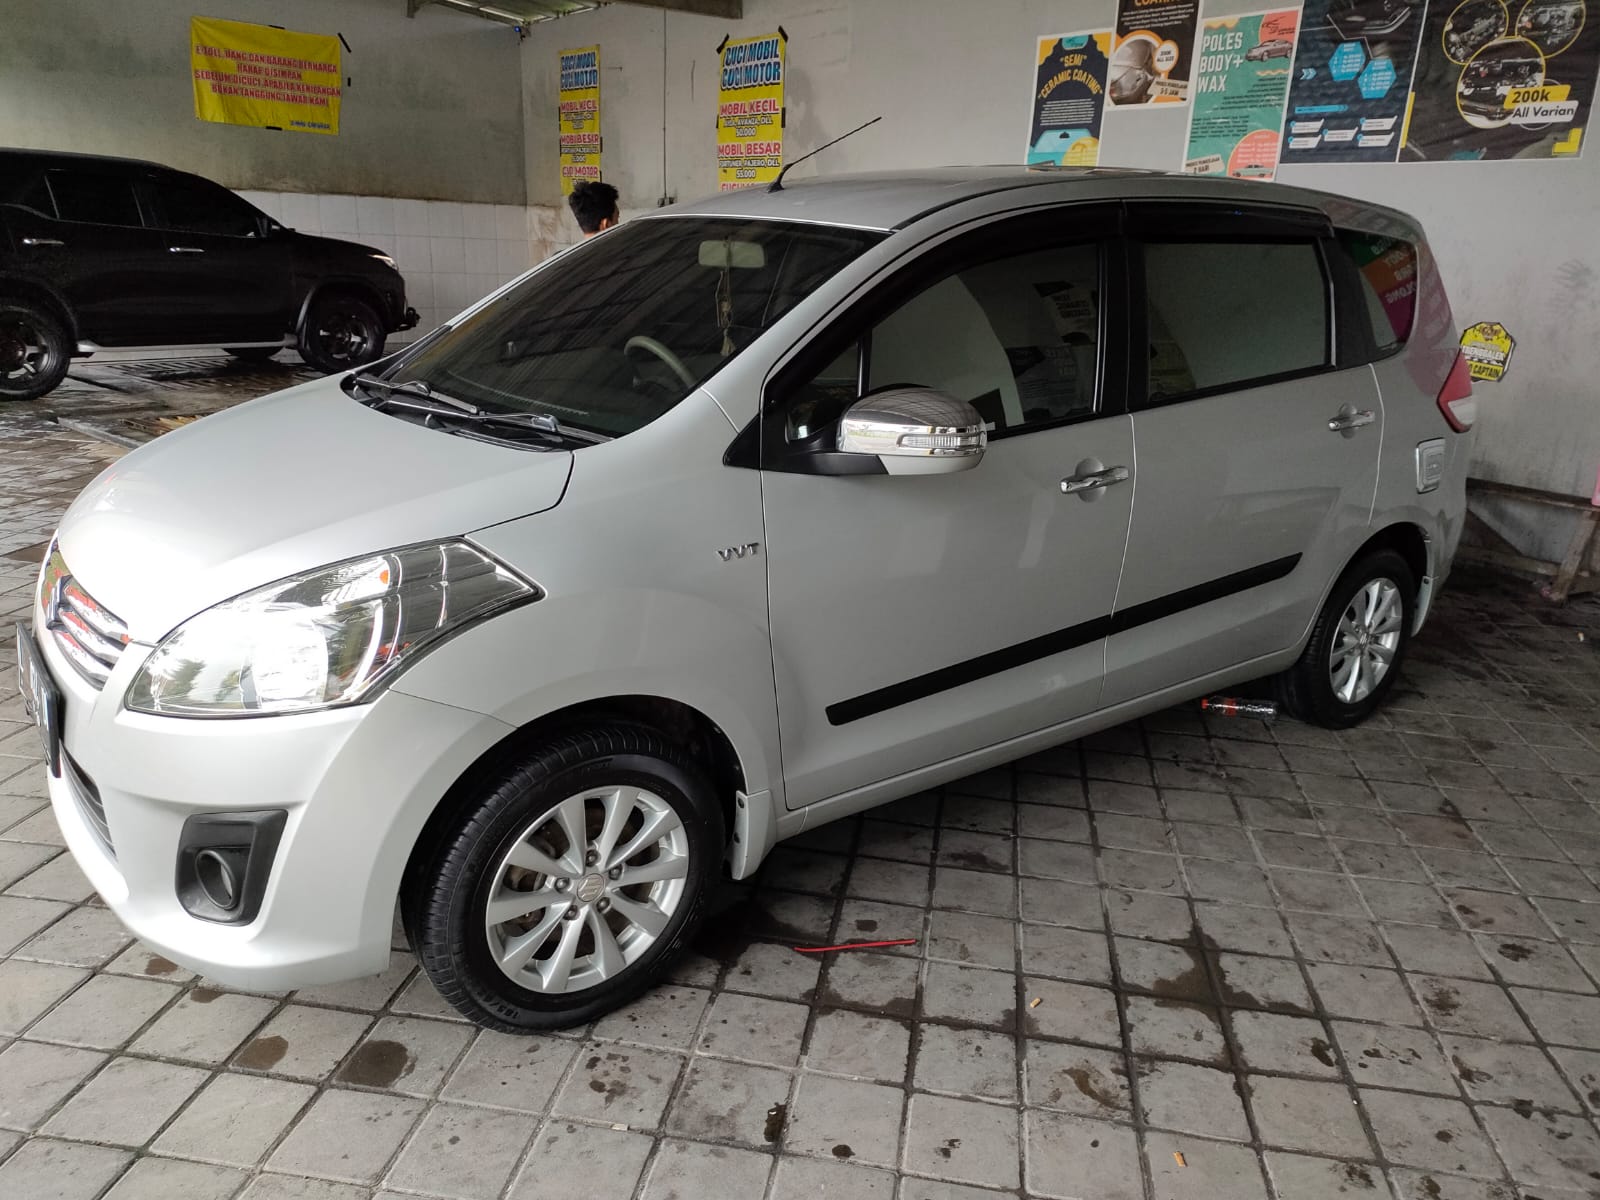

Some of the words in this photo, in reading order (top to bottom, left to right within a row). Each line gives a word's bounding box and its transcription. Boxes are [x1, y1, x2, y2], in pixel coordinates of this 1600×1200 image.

[1202, 32, 1243, 52] POLES
[726, 45, 747, 66] CUCI
[747, 39, 779, 62] MOBIL
[1200, 54, 1244, 73] BODY+
[722, 66, 743, 87] CUCI
[744, 62, 781, 84] MOTOR
[1197, 75, 1227, 93] WAX
[1512, 89, 1551, 103] 200k
[720, 102, 747, 115] MOBIL
[749, 99, 780, 112] KECIL
[1512, 107, 1529, 118] All
[1533, 105, 1574, 117] Varian
[718, 144, 743, 155] MOBIL
[746, 142, 781, 154] BESAR
[575, 166, 598, 177] MOTOR
[736, 170, 756, 178] 55.000
[1472, 364, 1501, 379] CAPTAIN
[716, 543, 759, 561] VVT
